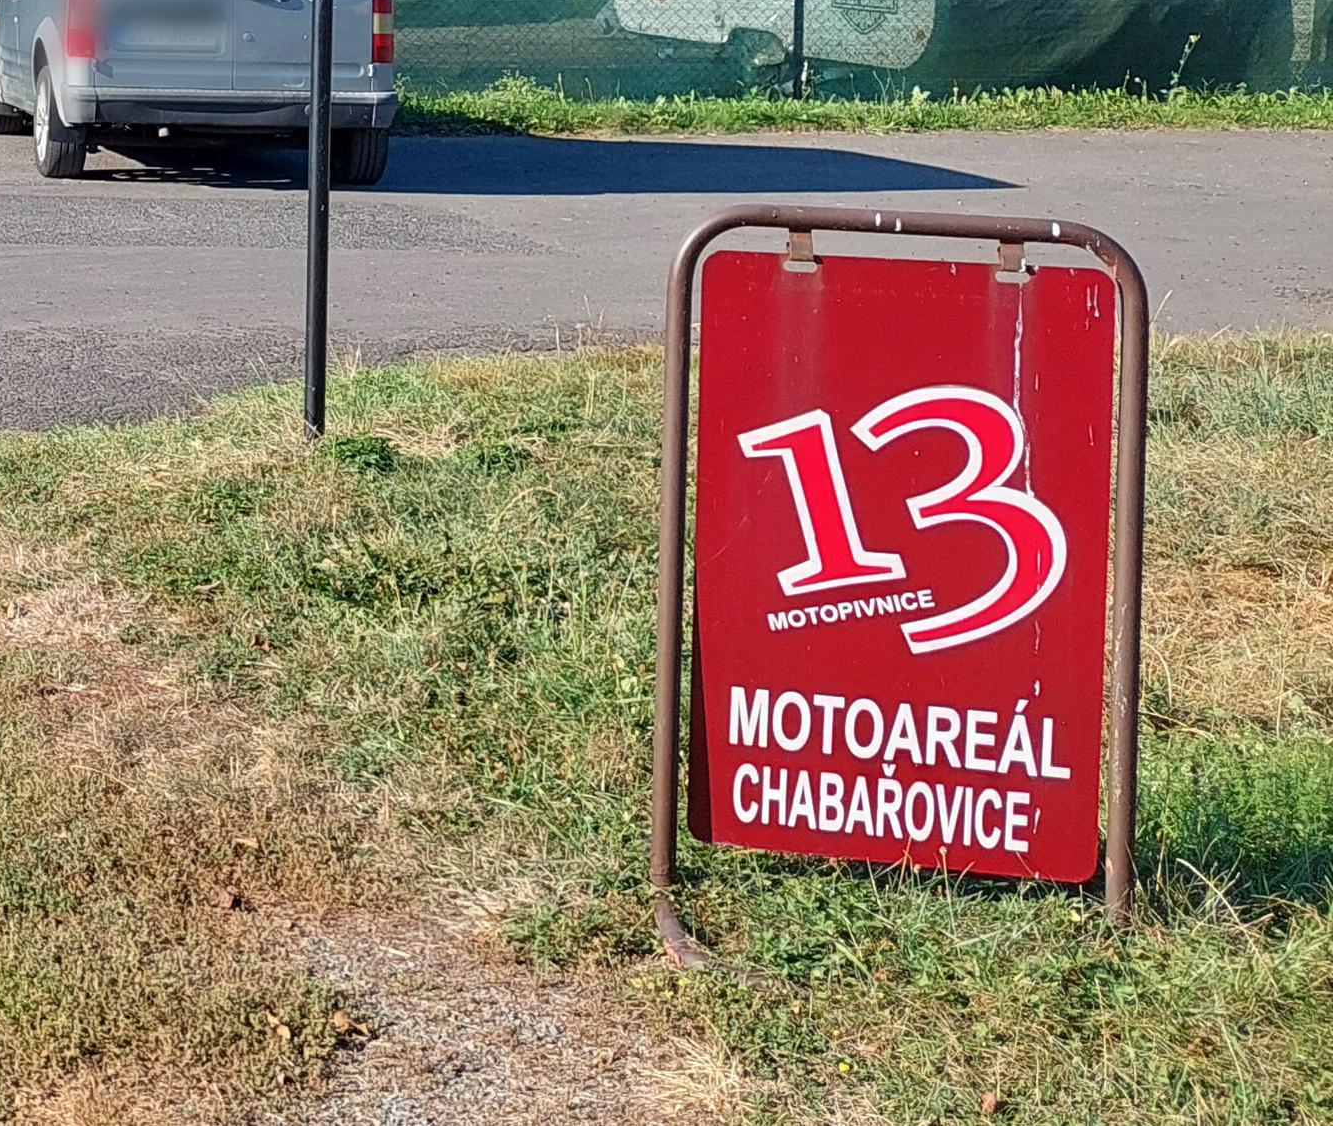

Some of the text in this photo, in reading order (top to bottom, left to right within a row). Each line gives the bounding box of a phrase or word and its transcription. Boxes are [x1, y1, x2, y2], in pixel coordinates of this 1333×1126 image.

[737, 385, 1067, 655] 13
[767, 588, 936, 632] MOTOPIVNICE
[729, 686, 1071, 780] MOTOAREÁL
[733, 762, 1030, 853] CHABAŘOVICE
